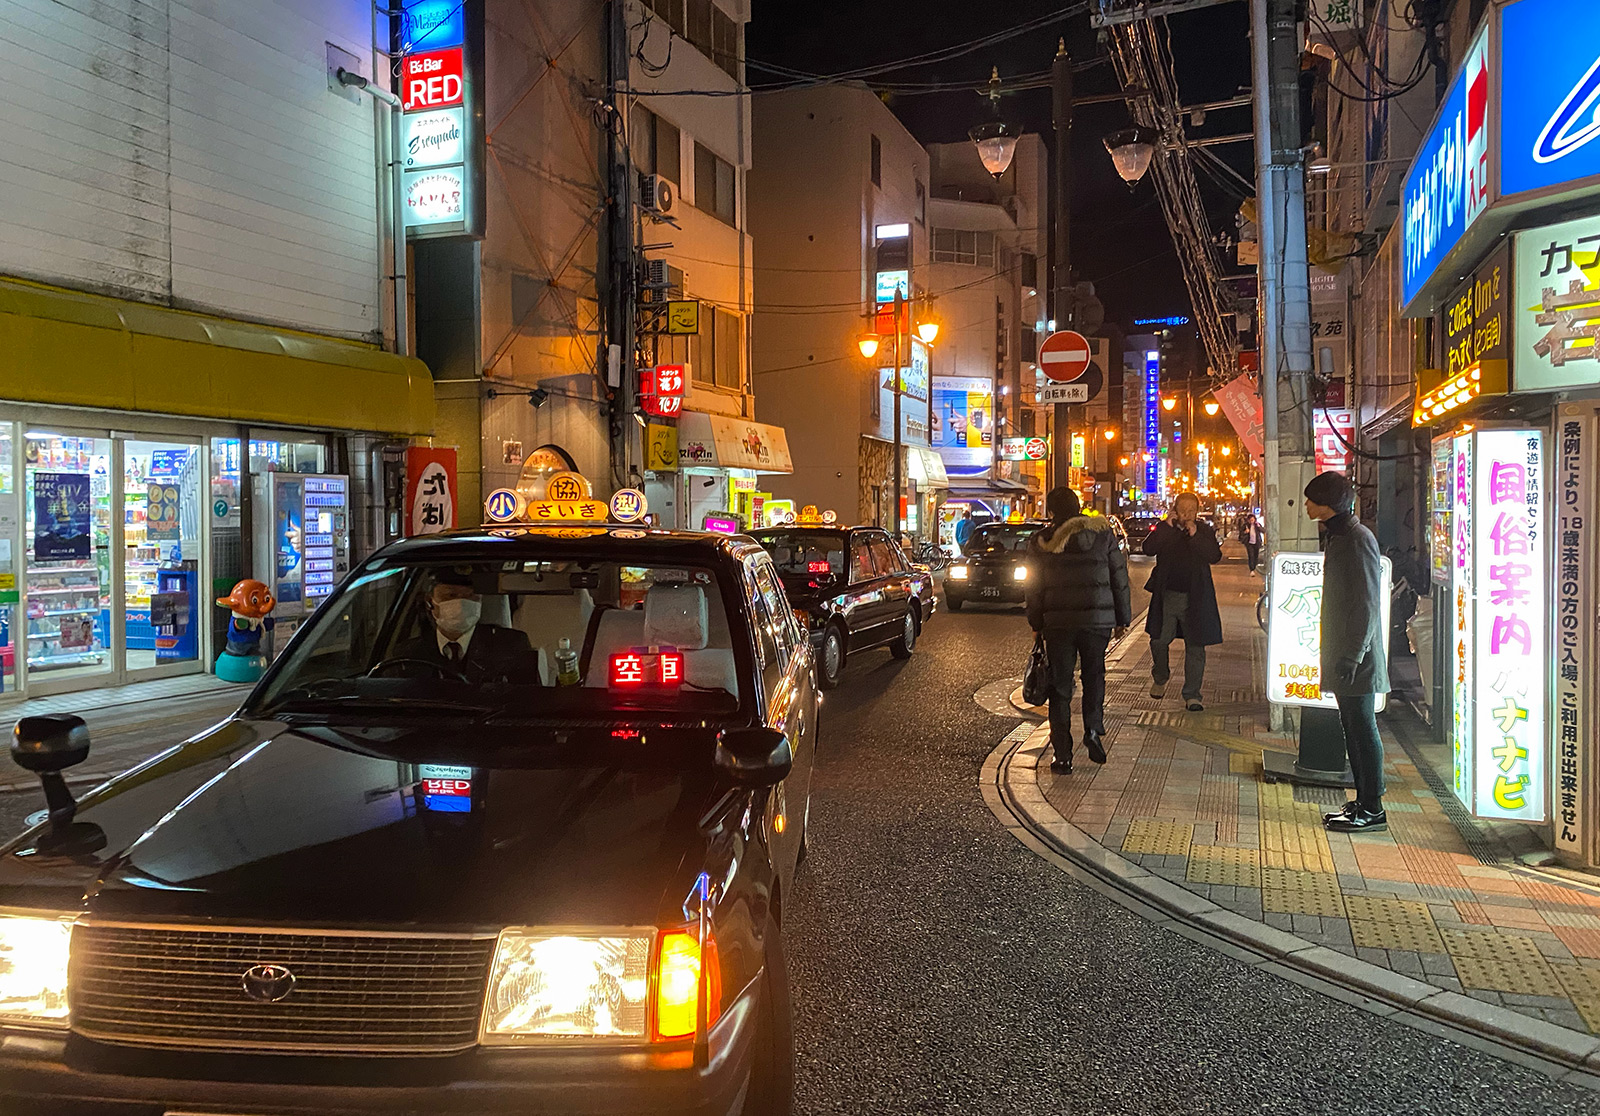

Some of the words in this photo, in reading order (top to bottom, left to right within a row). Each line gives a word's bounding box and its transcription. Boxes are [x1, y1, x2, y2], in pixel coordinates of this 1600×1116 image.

[423, 58, 443, 72] Bar
[410, 74, 462, 107] RED
[408, 124, 460, 154] Escapade
[1467, 151, 1487, 222] 入口
[1310, 275, 1336, 284] LIGHT
[659, 376, 681, 391] 花月
[1044, 388, 1084, 399] 自転車を除く
[553, 480, 578, 498] 協
[1526, 437, 1539, 551] 夜遊び情報センター
[491, 493, 513, 516] 小
[537, 503, 596, 518] さいき
[615, 495, 638, 516] 型
[713, 521, 728, 529] Club
[1490, 460, 1531, 656] 風俗案内
[1282, 560, 1322, 576] 無料
[1279, 663, 1318, 681] 10年
[1285, 682, 1322, 699] 実績
